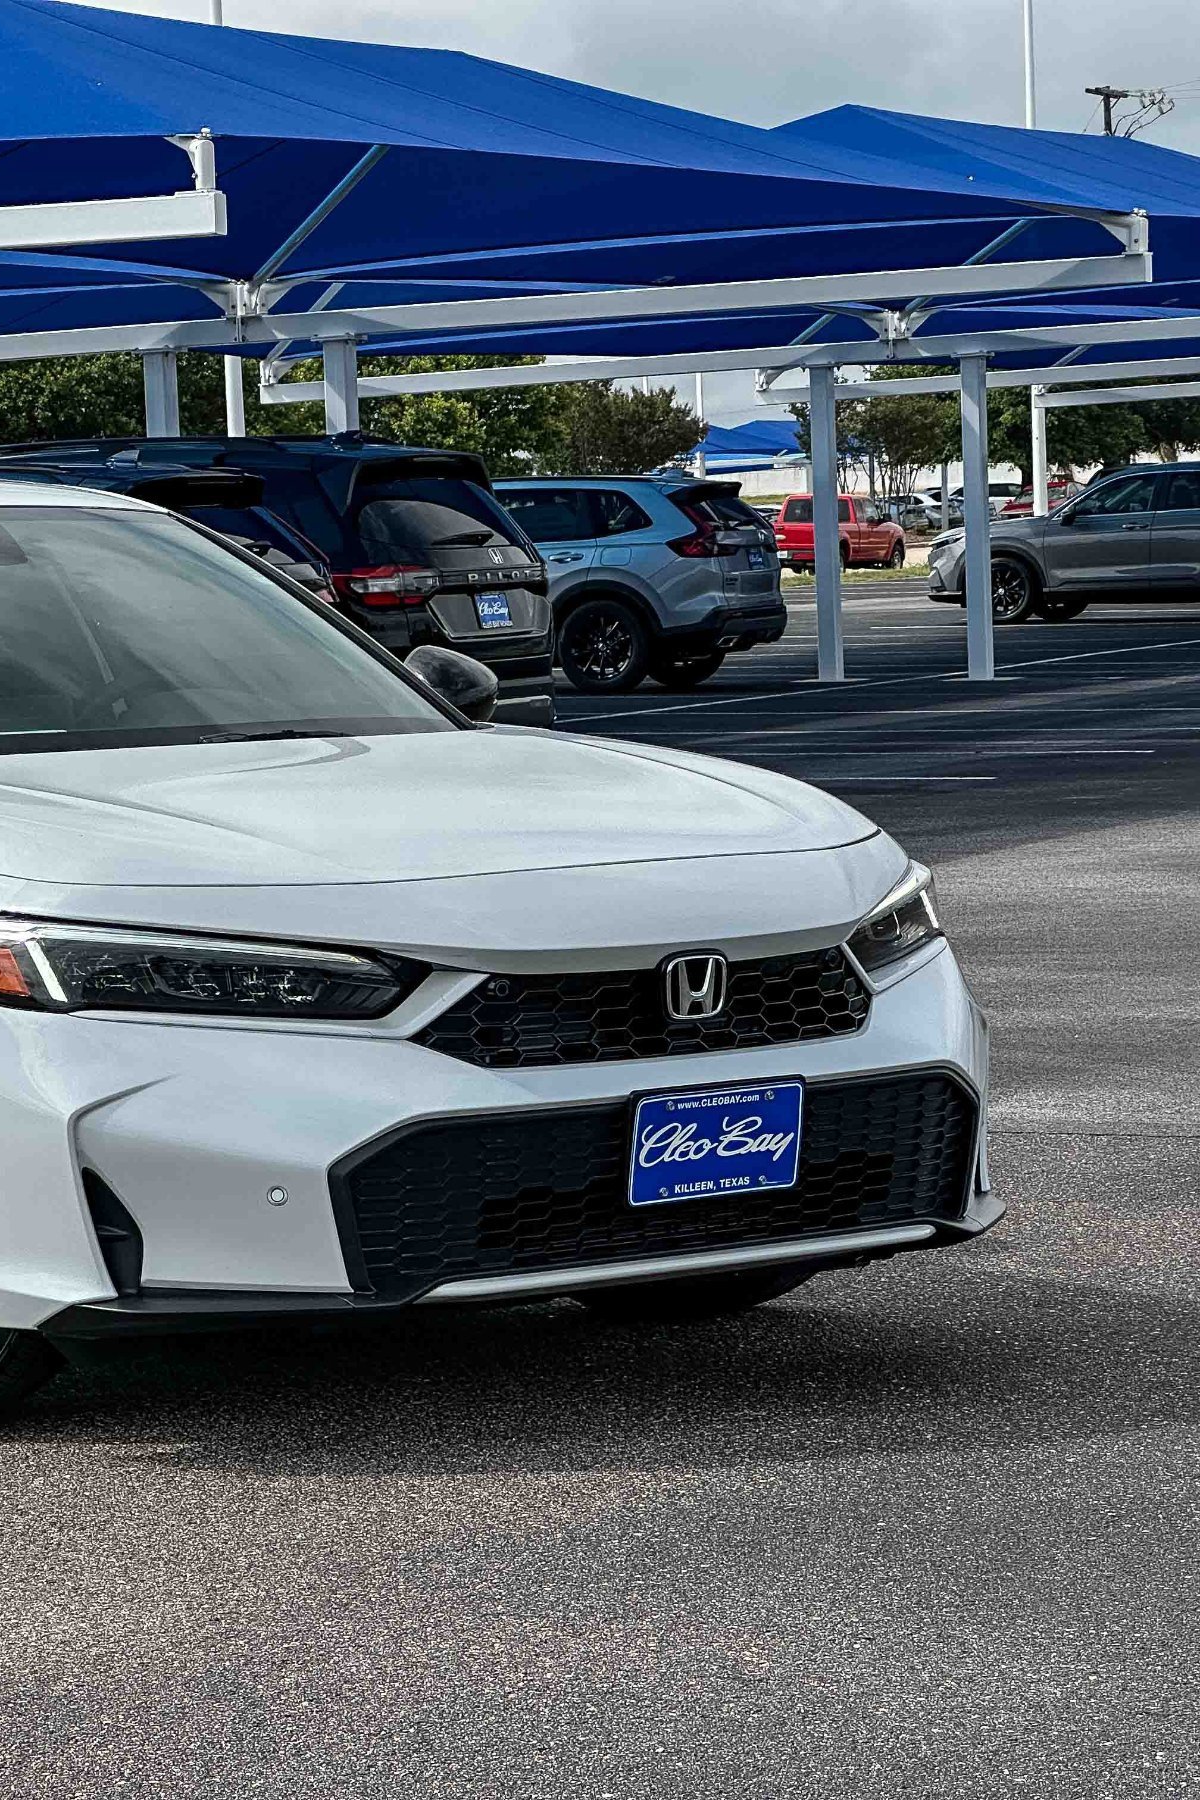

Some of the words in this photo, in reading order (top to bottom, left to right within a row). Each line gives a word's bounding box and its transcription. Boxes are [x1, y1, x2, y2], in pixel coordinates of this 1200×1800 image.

[468, 570, 531, 583] PILOT
[677, 1094, 760, 1110] www.CLEOBAY.com
[639, 1122, 718, 1168] Cleo
[716, 1116, 795, 1162] Bay
[674, 1179, 717, 1194] KILLEEN,
[719, 1176, 750, 1188] TEXAS
